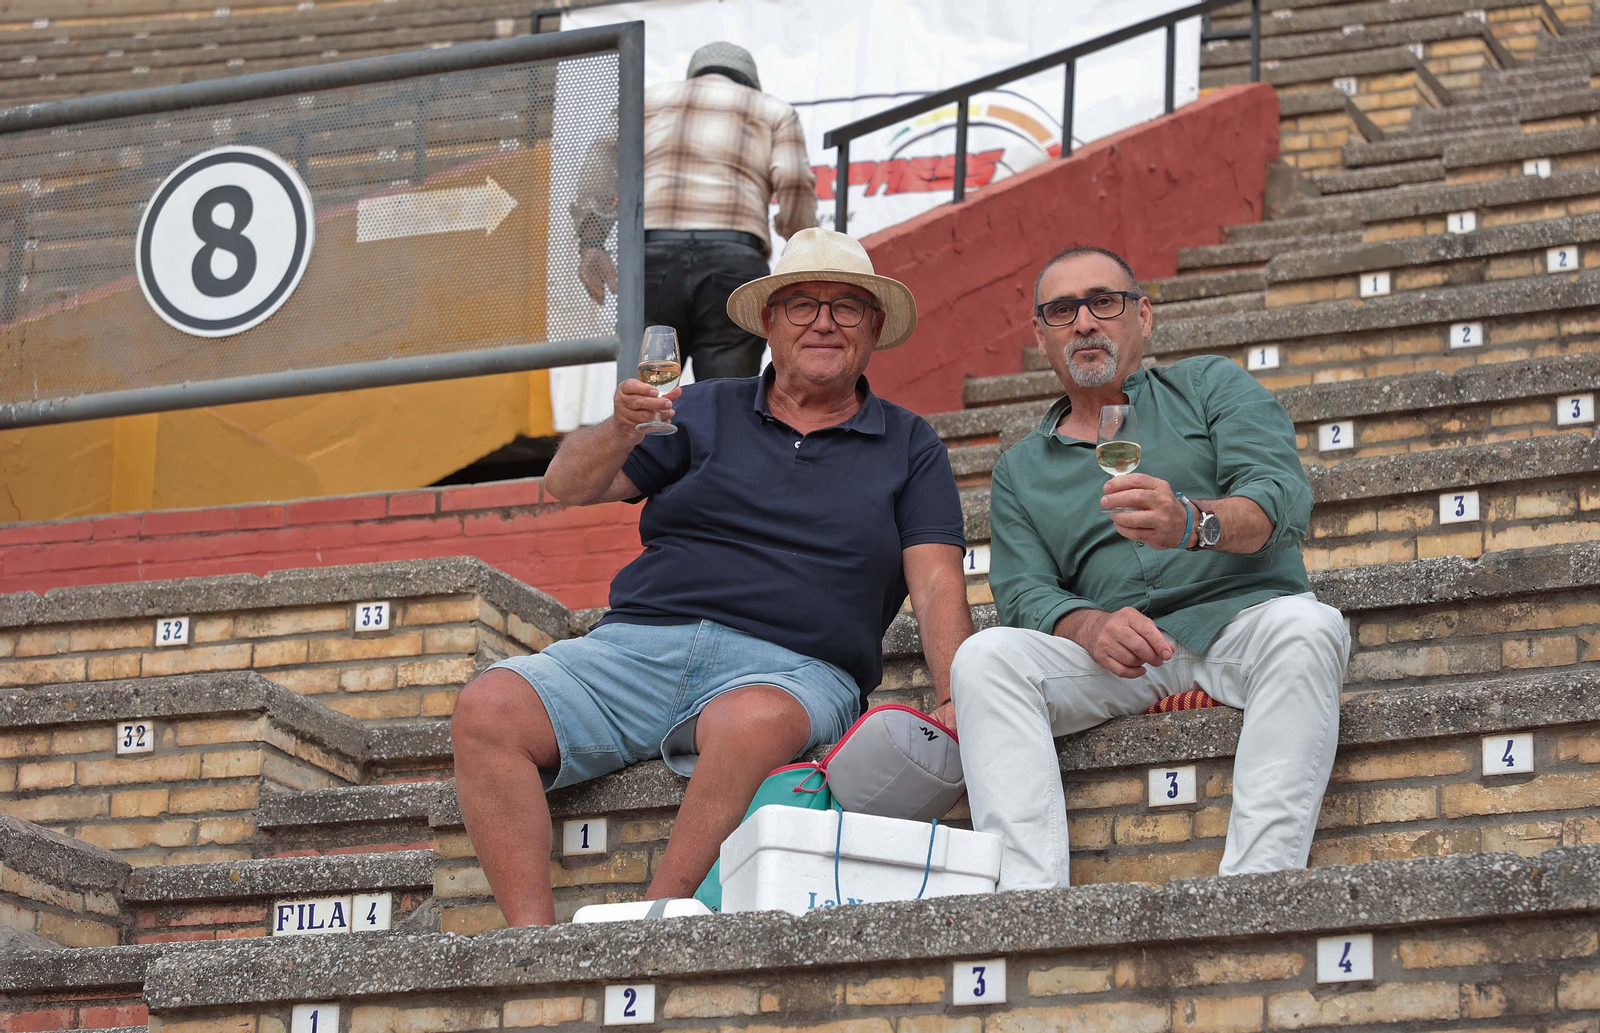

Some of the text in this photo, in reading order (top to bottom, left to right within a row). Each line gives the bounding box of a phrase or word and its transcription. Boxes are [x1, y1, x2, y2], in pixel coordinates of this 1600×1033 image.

[1458, 215, 1464, 230] 1
[192, 185, 257, 297] 8
[1558, 252, 1567, 267] 2
[1372, 276, 1378, 292] 1
[1462, 327, 1471, 343] 2
[1259, 348, 1266, 365] 1
[1571, 398, 1581, 418] 3
[1331, 425, 1341, 443] 2
[1454, 495, 1465, 517] 3
[968, 549, 976, 570] 1
[362, 605, 383, 627] 33
[162, 621, 183, 641] 32
[123, 725, 146, 748] 32
[1502, 739, 1515, 767] 4
[1166, 772, 1179, 799] 3
[581, 823, 590, 849] 1
[276, 901, 377, 932] FILA 4
[1338, 941, 1353, 973] 4
[972, 966, 986, 997] 3
[623, 988, 637, 1017] 2
[309, 1010, 319, 1033] 1
